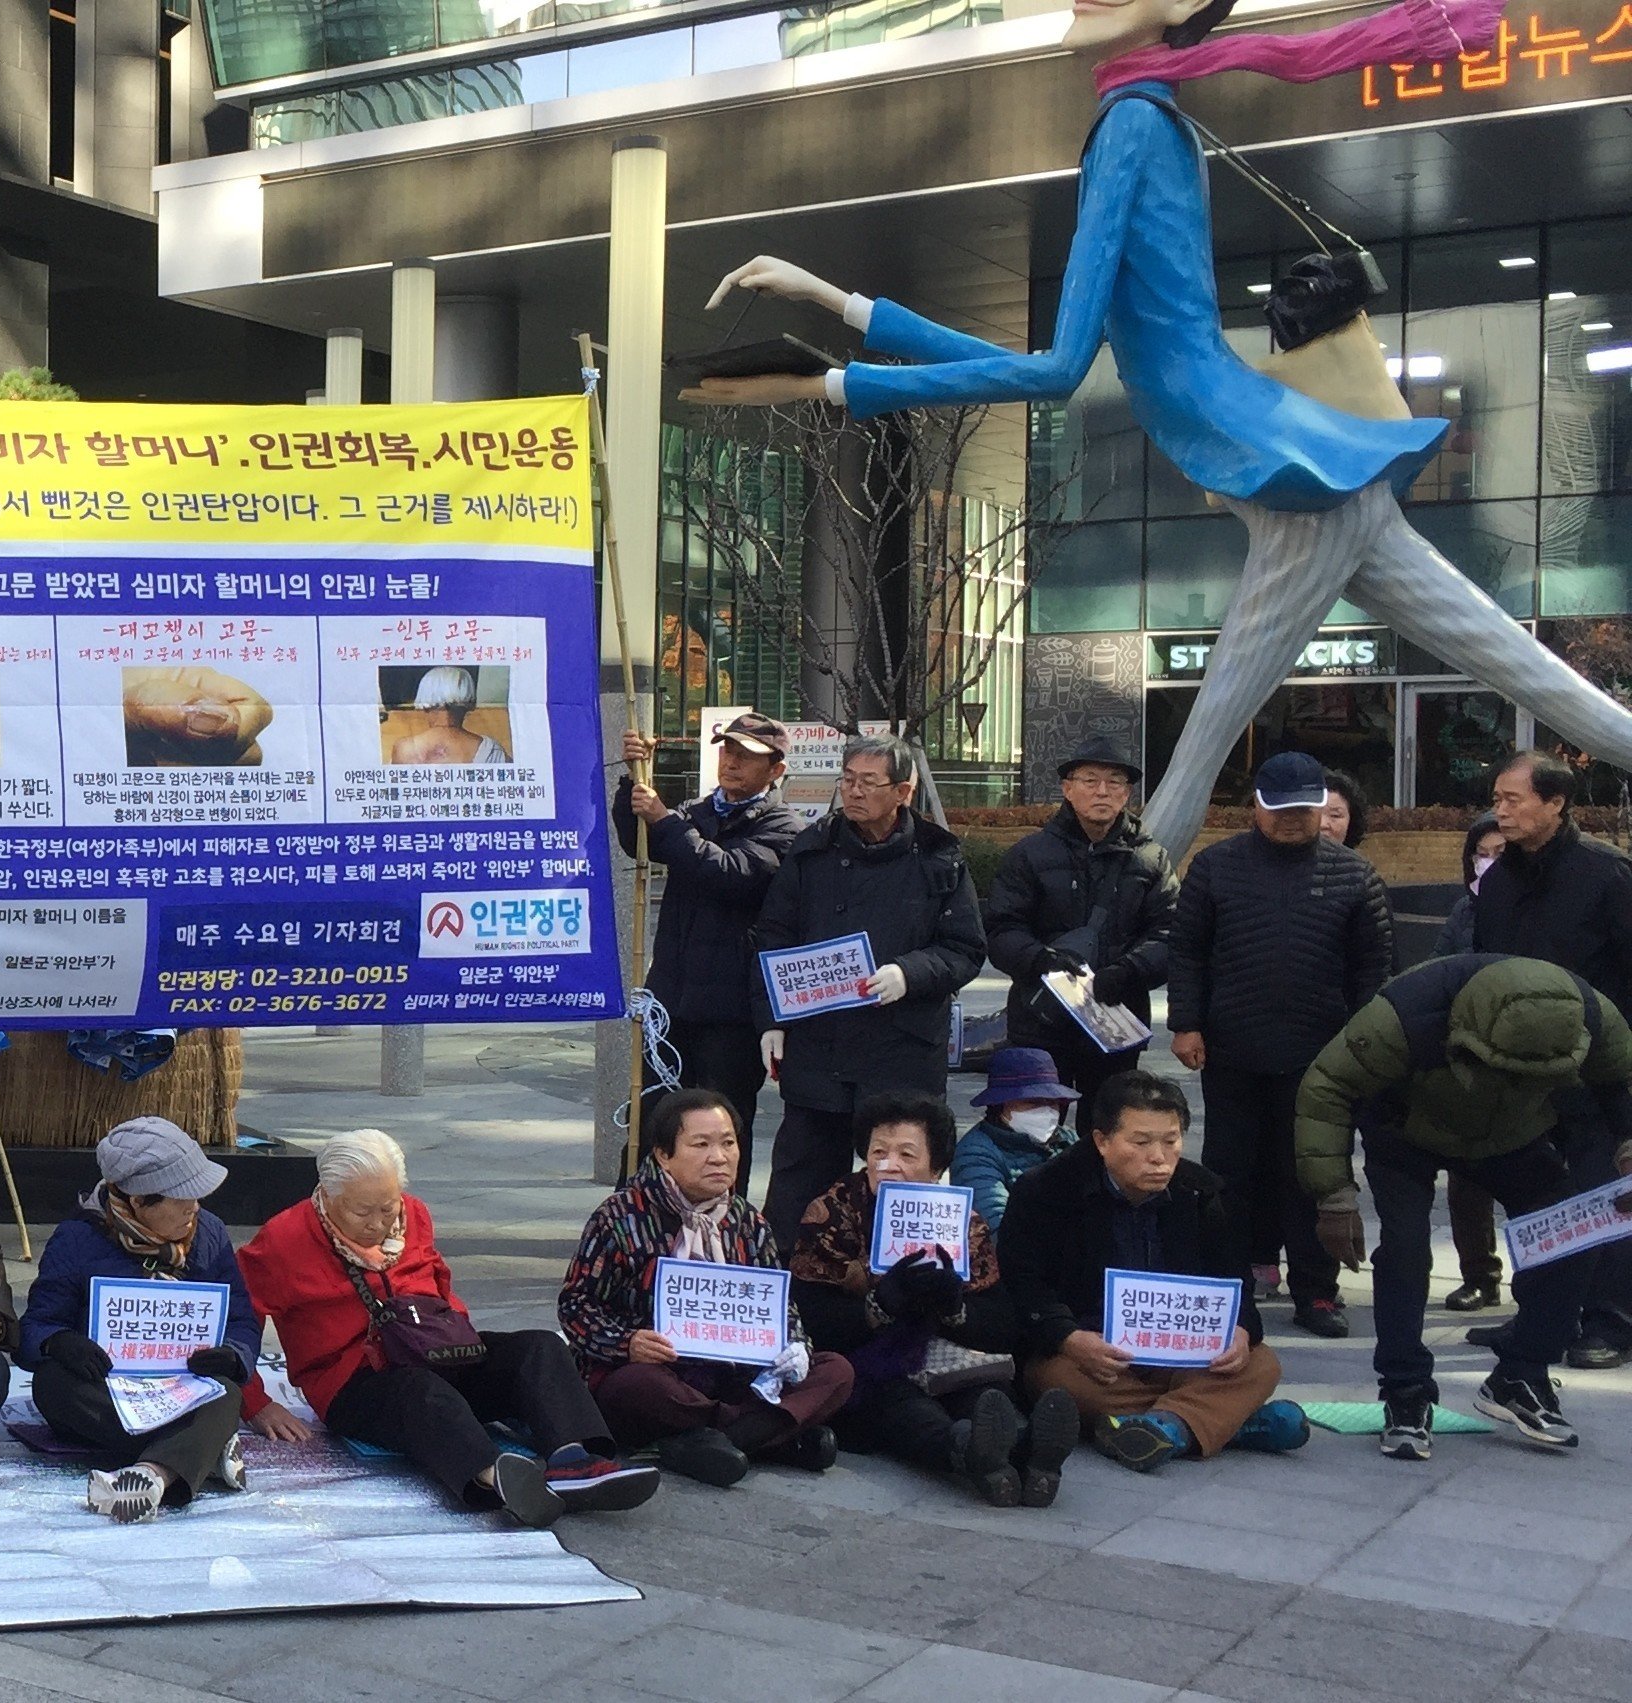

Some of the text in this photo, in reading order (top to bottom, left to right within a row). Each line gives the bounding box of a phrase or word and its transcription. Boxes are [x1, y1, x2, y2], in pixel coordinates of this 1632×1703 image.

[142, 491, 328, 523] 인권탄압이다.
[340, 494, 367, 520] 그
[376, 493, 452, 525] 근거를
[463, 493, 579, 529] 제시하라!)
[45, 572, 121, 600] 받았던
[131, 573, 206, 600] 심미자
[214, 573, 311, 600] 할머니의
[320, 573, 376, 600] 인권!
[385, 572, 440, 599] 눈물!
[8, 802, 53, 818] 쑤신다.
[202, 835, 270, 857] 피해자로
[275, 834, 340, 857] 인정받아
[345, 833, 377, 855] 정부
[382, 831, 444, 854] 위로금과
[448, 830, 536, 853] 생활지원금을
[540, 829, 578, 850] 받았던
[23, 868, 109, 889] 인권유린의
[115, 868, 168, 889] 혹독한
[173, 867, 225, 888] 고초를
[230, 865, 299, 886] 겪으시다,
[305, 864, 337, 884] 피를
[343, 863, 376, 883] 토해
[432, 861, 476, 881] 죽어간
[483, 859, 535, 880] ‘위안부’
[541, 858, 595, 878] 할머니다.
[34, 907, 76, 924] 할머니
[83, 907, 126, 924] 이름을
[470, 897, 582, 937] 인권정당
[176, 919, 401, 945] 매주 수요일 기자회견
[475, 940, 579, 951] HUMAN RIGHTS POLITICAL PARTY
[157, 965, 408, 992] 인권정당: 02-3210-0915
[459, 964, 560, 985] 일본군 ‘위안부’
[779, 964, 863, 993] 일본군위안부
[69, 996, 117, 1008] 나서라!
[170, 993, 388, 1013] FAX: 02-3676-3672
[403, 992, 606, 1010] 심미자 할머니 인권조사위원회
[890, 1219, 959, 1241] 일본군위안부
[665, 1274, 775, 1301] 심미자沈美子
[106, 1297, 214, 1320] 심미자沈美子
[666, 1296, 773, 1325] 일본군위안부
[1121, 1288, 1227, 1312] 심미자沈美子
[107, 1319, 210, 1342] 일본군위안부
[1121, 1309, 1222, 1333] 일본군위안부
